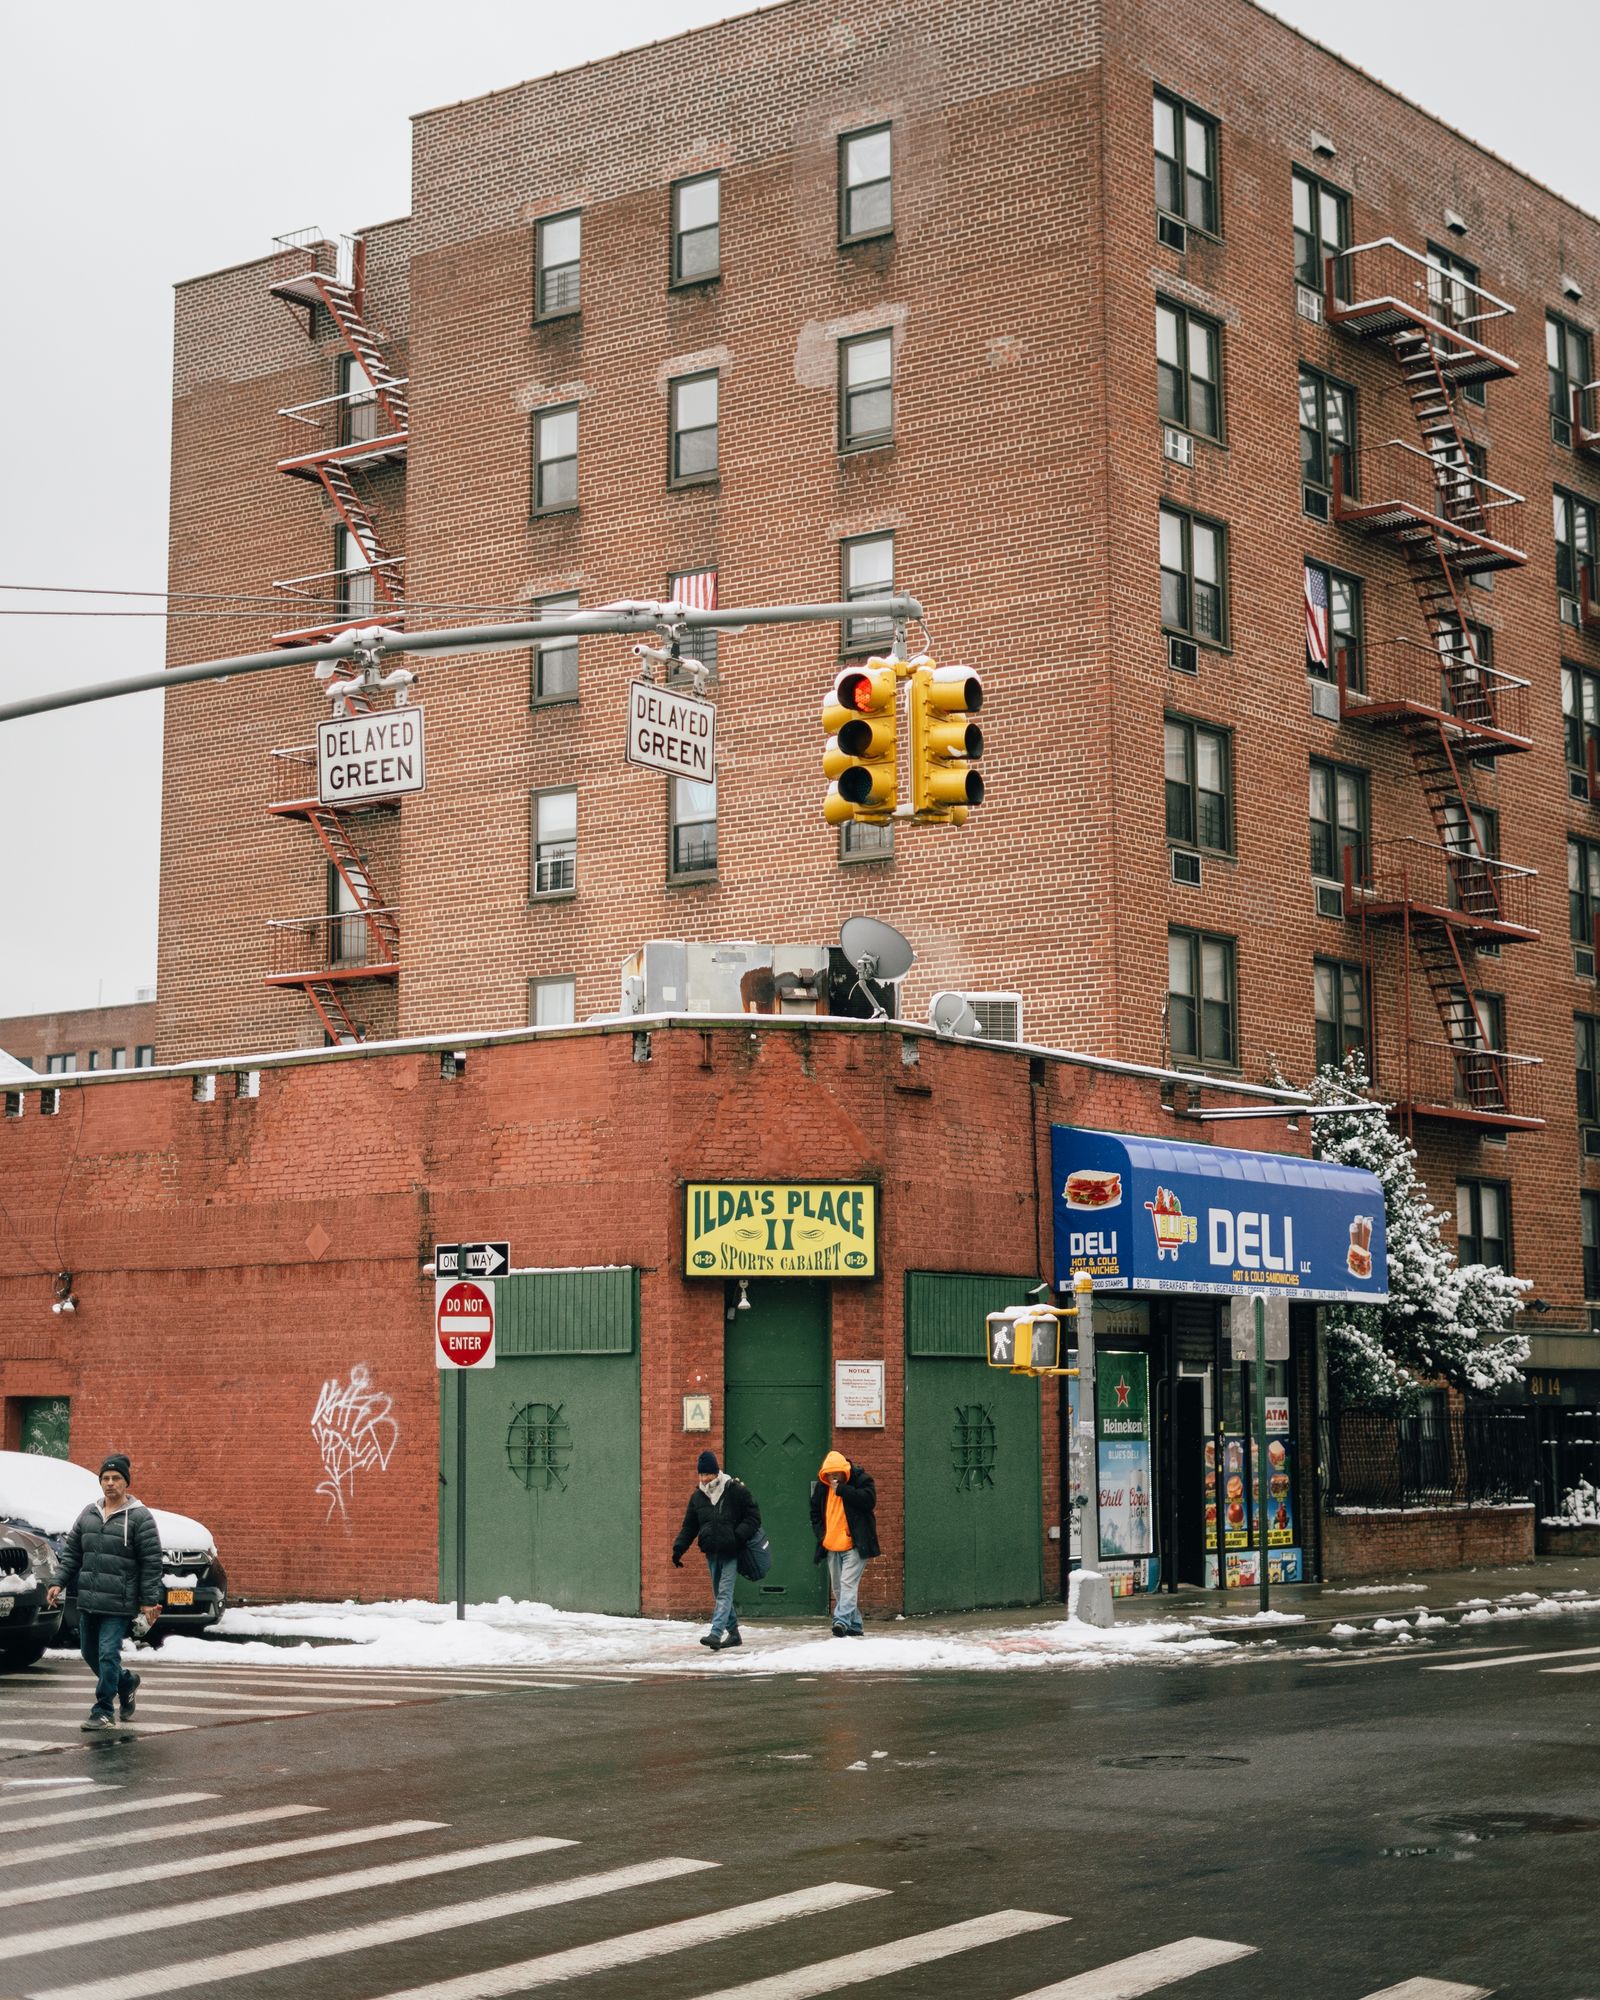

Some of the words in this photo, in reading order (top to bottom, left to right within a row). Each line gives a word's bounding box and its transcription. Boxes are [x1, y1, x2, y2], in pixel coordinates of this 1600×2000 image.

[637, 693, 709, 738] DELAYED
[326, 721, 414, 758] DELAYED
[638, 727, 707, 770] GREEN
[330, 755, 413, 790] GREEN
[694, 1190, 775, 1241] ILDA'S
[787, 1190, 865, 1240] PLACE
[765, 1219, 795, 1250] II
[1070, 1231, 1117, 1256] DELI
[1208, 1208, 1294, 1272] DELI
[443, 1256, 458, 1268] ON
[472, 1254, 494, 1267] WAY
[720, 1242, 774, 1270] SPORTS
[780, 1242, 841, 1270] CABARET
[1071, 1258, 1087, 1267] HOT
[1089, 1257, 1095, 1266] &
[1097, 1257, 1118, 1266] COLD
[1300, 1261, 1312, 1273] LLC
[1105, 1280, 1124, 1288] STAMPS
[1232, 1270, 1244, 1282] HOT
[1244, 1271, 1250, 1282] &
[1250, 1272, 1265, 1283] COLD
[1265, 1273, 1300, 1286] SANDWICHES
[1159, 1281, 1188, 1291] BREAKFAST
[1192, 1283, 1209, 1293] FRUITS
[1214, 1285, 1244, 1295] VEGETABLES
[1269, 1288, 1281, 1296] SODA
[1286, 1288, 1297, 1297] BEER
[1303, 1289, 1313, 1298] ATM
[447, 1299, 460, 1312] DO
[464, 1299, 484, 1312] NOT
[449, 1337, 482, 1350] ENTER
[690, 1403, 705, 1421] A
[1266, 1409, 1288, 1420] ATM
[1103, 1418, 1143, 1434] Heineken
[1099, 1489, 1124, 1507] Chill
